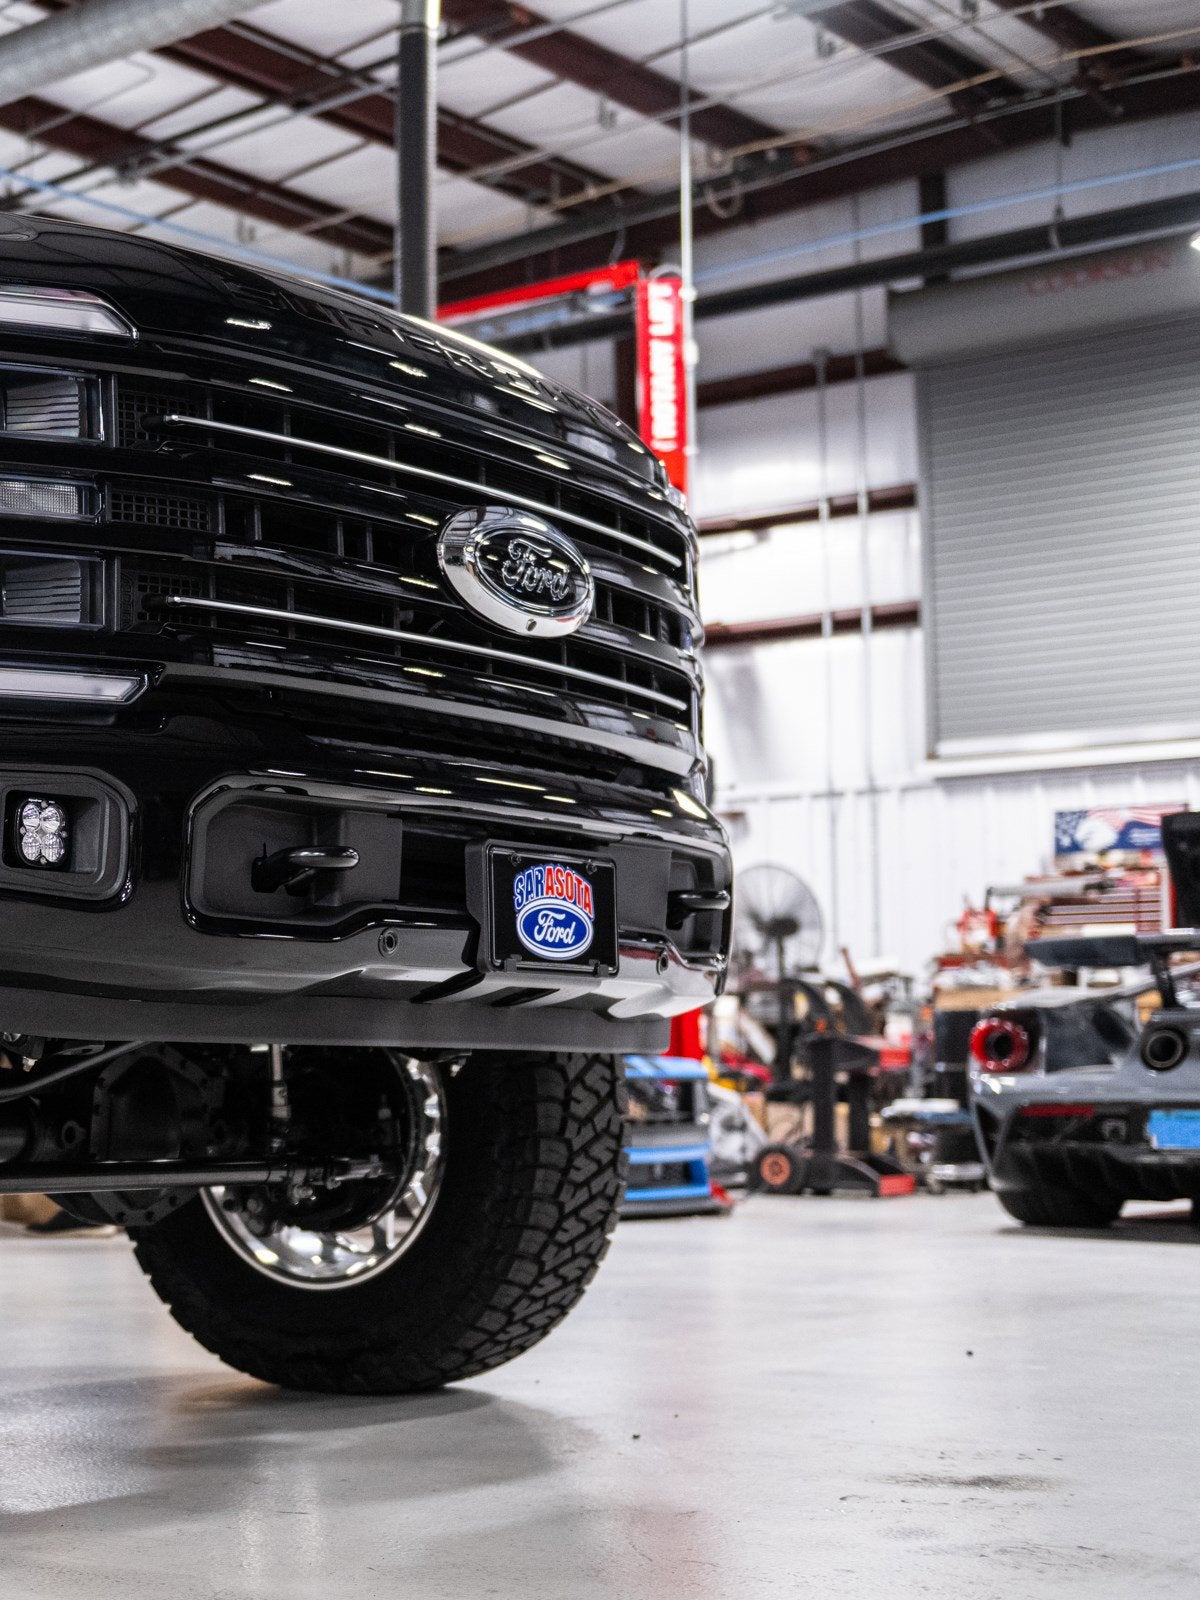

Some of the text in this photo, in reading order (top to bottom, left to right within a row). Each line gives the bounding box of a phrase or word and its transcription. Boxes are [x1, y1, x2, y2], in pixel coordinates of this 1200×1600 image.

[501, 538, 570, 600] Ford
[514, 865, 594, 919] SARASOTA
[534, 910, 576, 945] Ford
